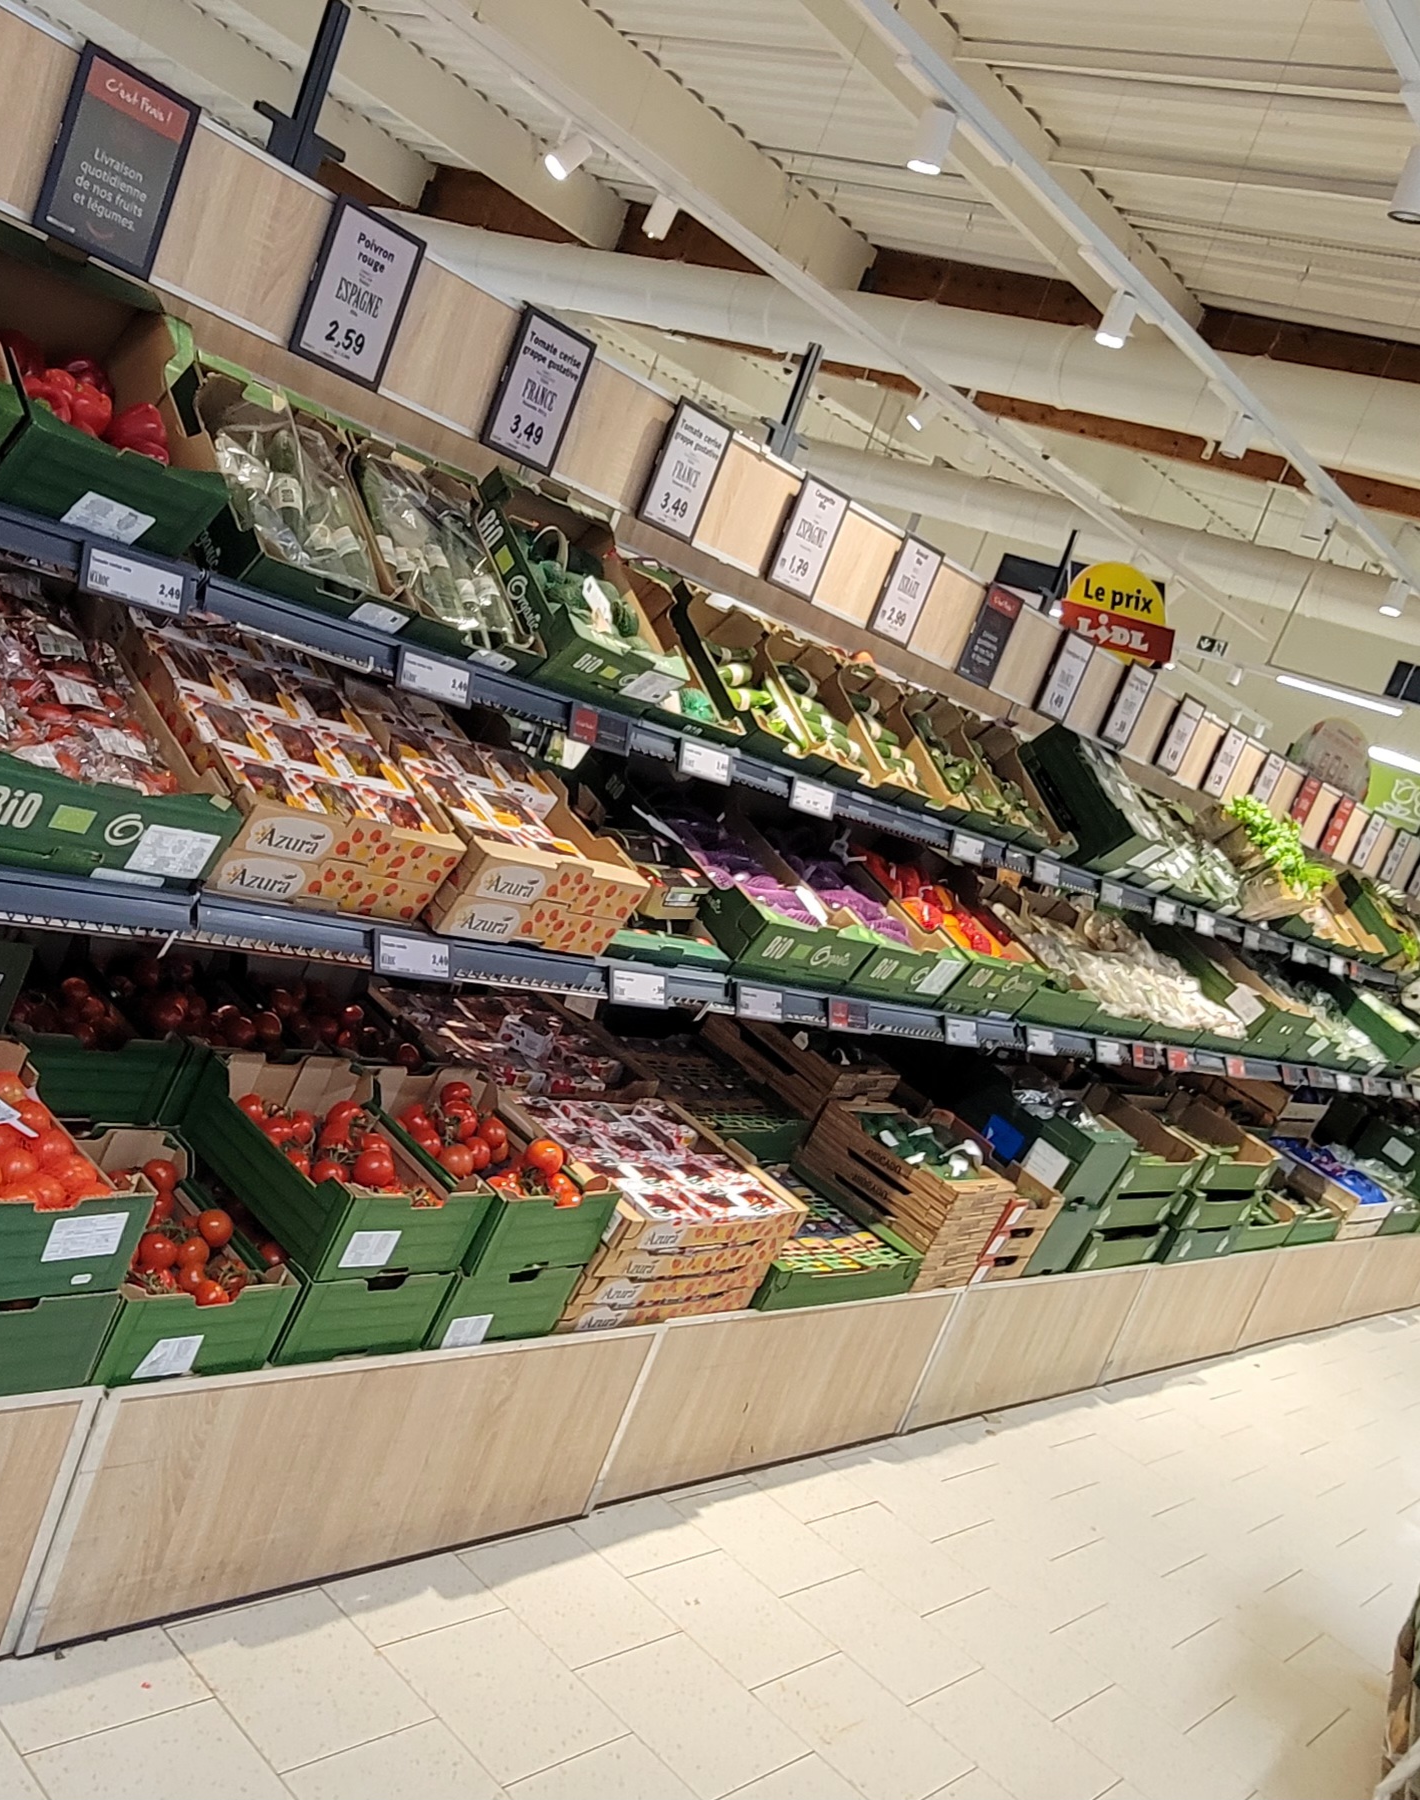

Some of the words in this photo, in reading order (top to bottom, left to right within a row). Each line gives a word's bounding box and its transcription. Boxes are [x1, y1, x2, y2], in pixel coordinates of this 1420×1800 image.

[94, 147, 143, 183] Livraison
[75, 174, 90, 190] de
[92, 183, 113, 201] nos
[114, 193, 143, 219] fruits
[80, 161, 147, 203] quotidienne
[73, 193, 85, 205] et
[357, 231, 395, 263] Poivron
[357, 252, 385, 273] rouge
[335, 277, 383, 319] ESPAGNE
[325, 320, 366, 356] 2,59
[530, 330, 558, 356] Tomate
[559, 351, 582, 371] cerise
[522, 345, 547, 366] grappe
[548, 360, 579, 383] gustative
[521, 378, 558, 413] FRANCE
[509, 414, 544, 446] 3,49
[681, 418, 703, 439] Tomate
[704, 432, 722, 451] cerise
[672, 460, 701, 490] FRANCE
[660, 491, 689, 519] 3,49
[194, 527, 221, 572] ganic
[796, 518, 828, 549] ESPAGNE
[788, 554, 810, 578] 1,79
[158, 583, 181, 601] 2,49
[1083, 578, 1106, 602] Le
[1110, 588, 1154, 614] prix
[886, 606, 907, 627] 2,99
